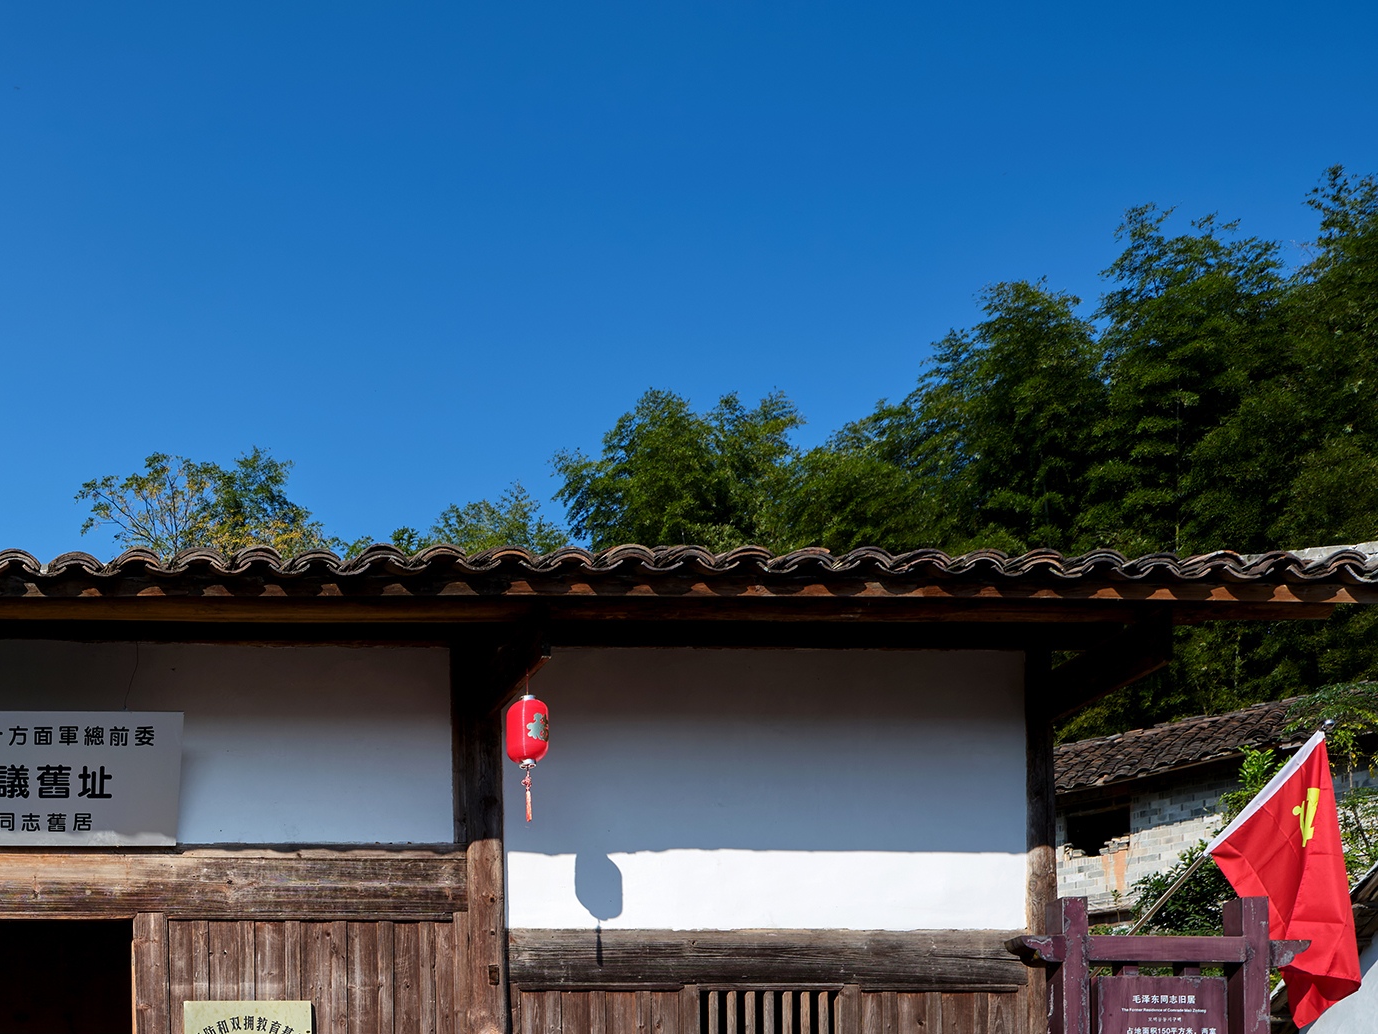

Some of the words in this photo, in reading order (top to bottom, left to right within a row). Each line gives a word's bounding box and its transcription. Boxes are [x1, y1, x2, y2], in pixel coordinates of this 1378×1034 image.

[1132, 994, 1196, 1004] 毛泽东同志旧居
